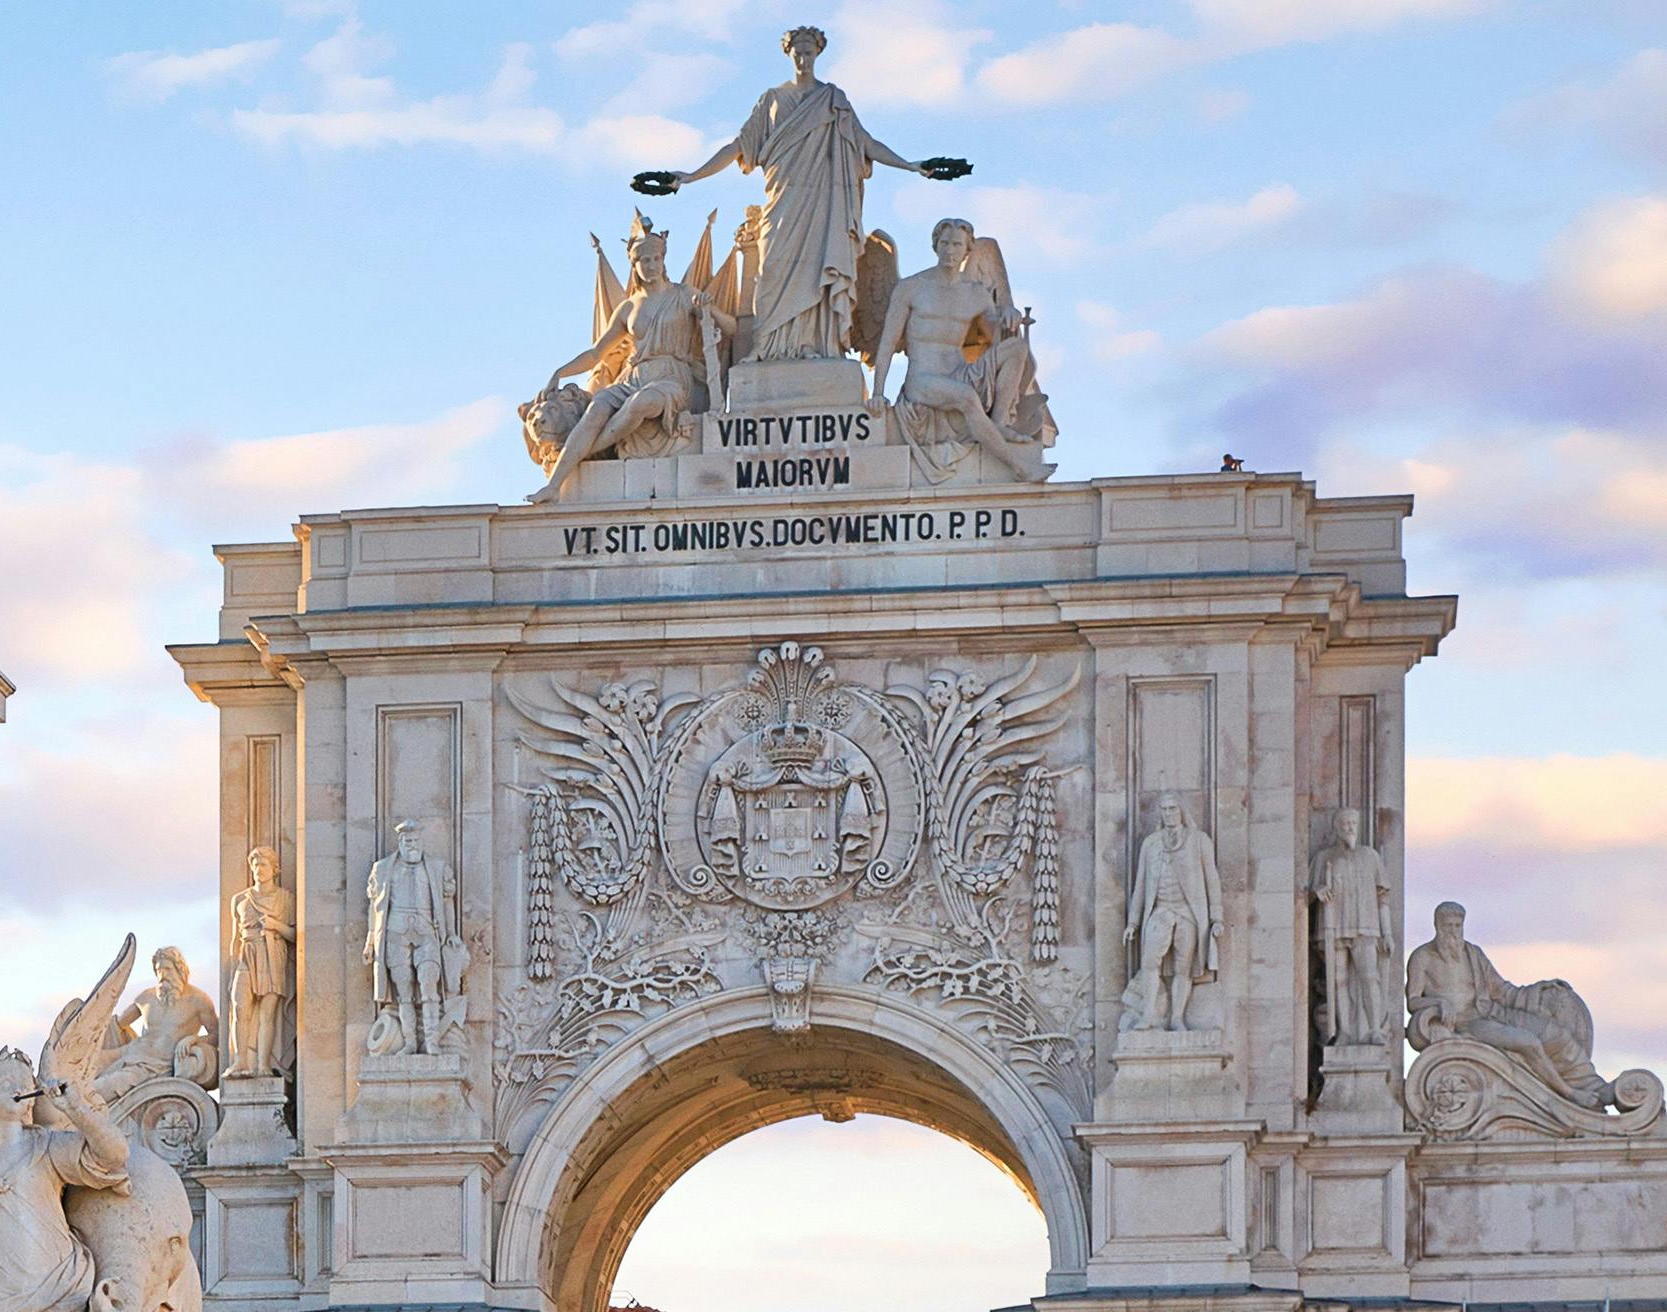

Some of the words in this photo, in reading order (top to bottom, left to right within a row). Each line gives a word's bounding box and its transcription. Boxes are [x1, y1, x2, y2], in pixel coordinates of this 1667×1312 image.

[718, 413, 870, 447] VIRTVTIBVS
[736, 456, 850, 489] MAIORVM
[605, 525, 647, 553] SIT.
